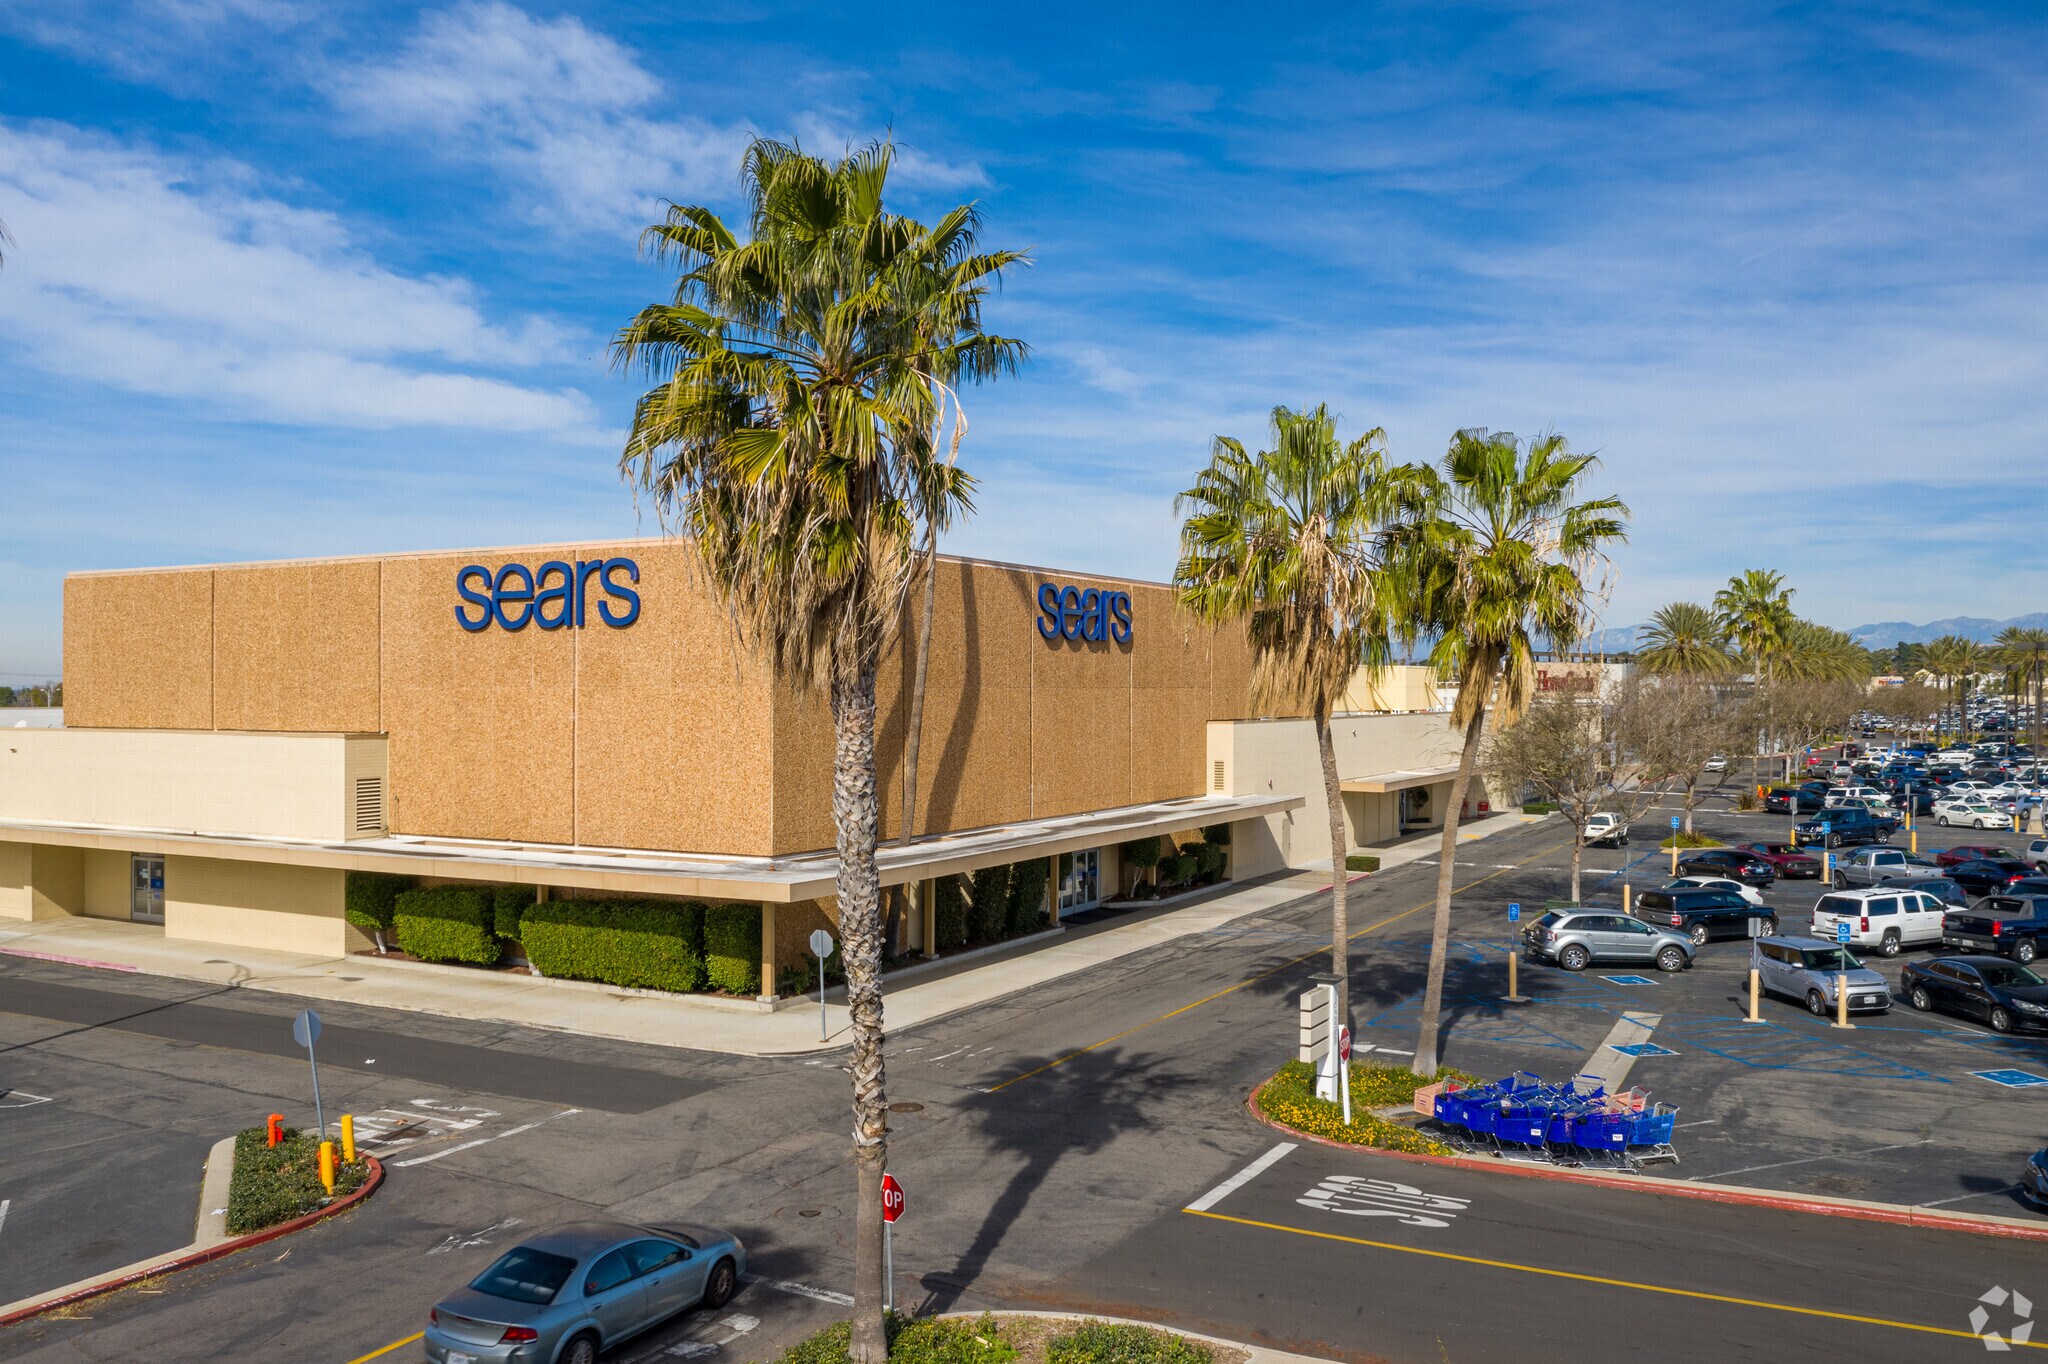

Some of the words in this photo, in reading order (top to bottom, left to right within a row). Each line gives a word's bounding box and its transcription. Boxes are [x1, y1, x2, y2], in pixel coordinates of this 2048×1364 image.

[454, 557, 641, 631] sears
[1037, 583, 1132, 643] sears
[882, 1189, 902, 1209] OP
[1296, 1175, 1472, 1228] STOP
